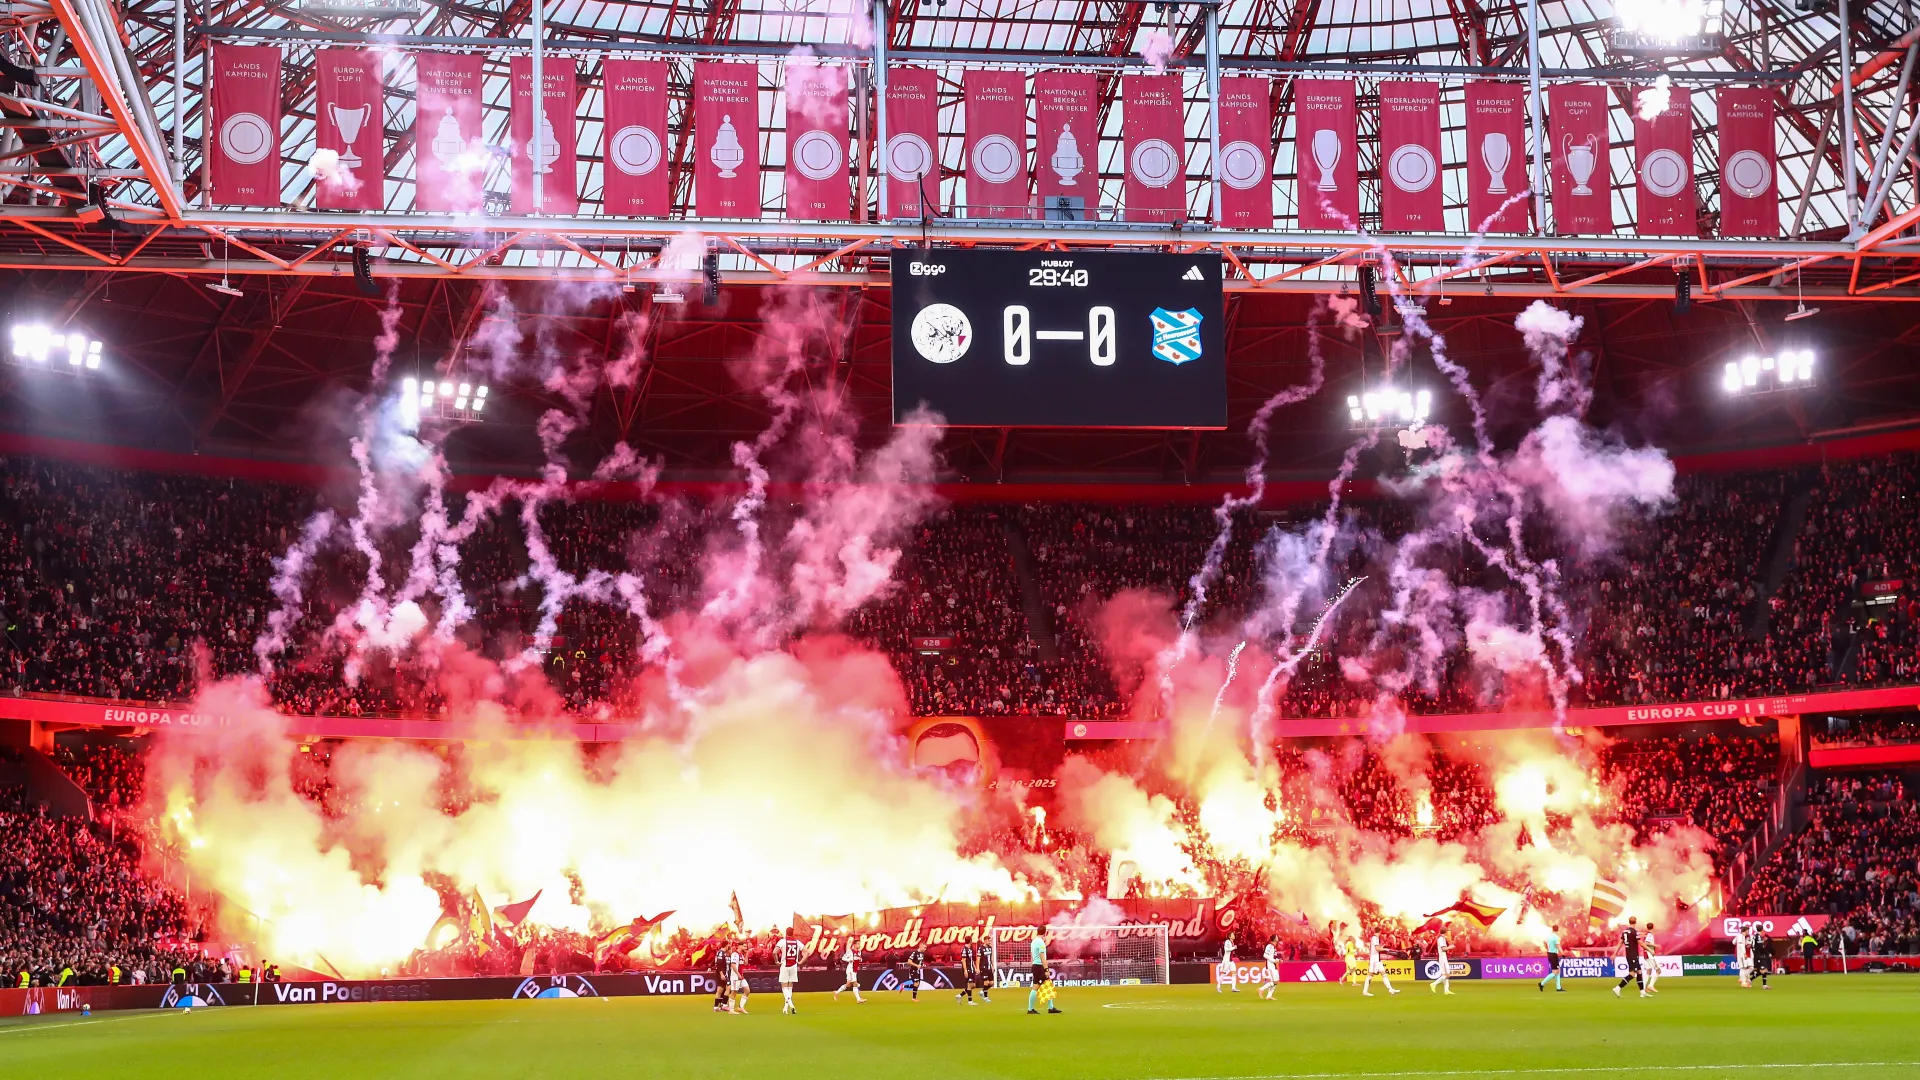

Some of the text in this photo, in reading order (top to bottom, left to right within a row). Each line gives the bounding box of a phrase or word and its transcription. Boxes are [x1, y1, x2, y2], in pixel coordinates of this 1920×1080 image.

[226, 70, 268, 78] KAMPIOEN
[426, 70, 472, 79] NATIONALE
[1029, 269, 1088, 287] 29:40
[104, 709, 171, 725] EUROPA
[1628, 706, 1696, 720] EUROPA
[1703, 704, 1737, 716] CUP
[927, 916, 996, 944] nooit
[1118, 904, 1205, 937] vriend
[787, 945, 796, 956] 25
[1559, 958, 1607, 967] VRIENDEN
[1563, 968, 1601, 977] LOTERIJ
[644, 976, 684, 993] Van
[57, 989, 70, 1009] Van
[274, 984, 315, 1002] Van
